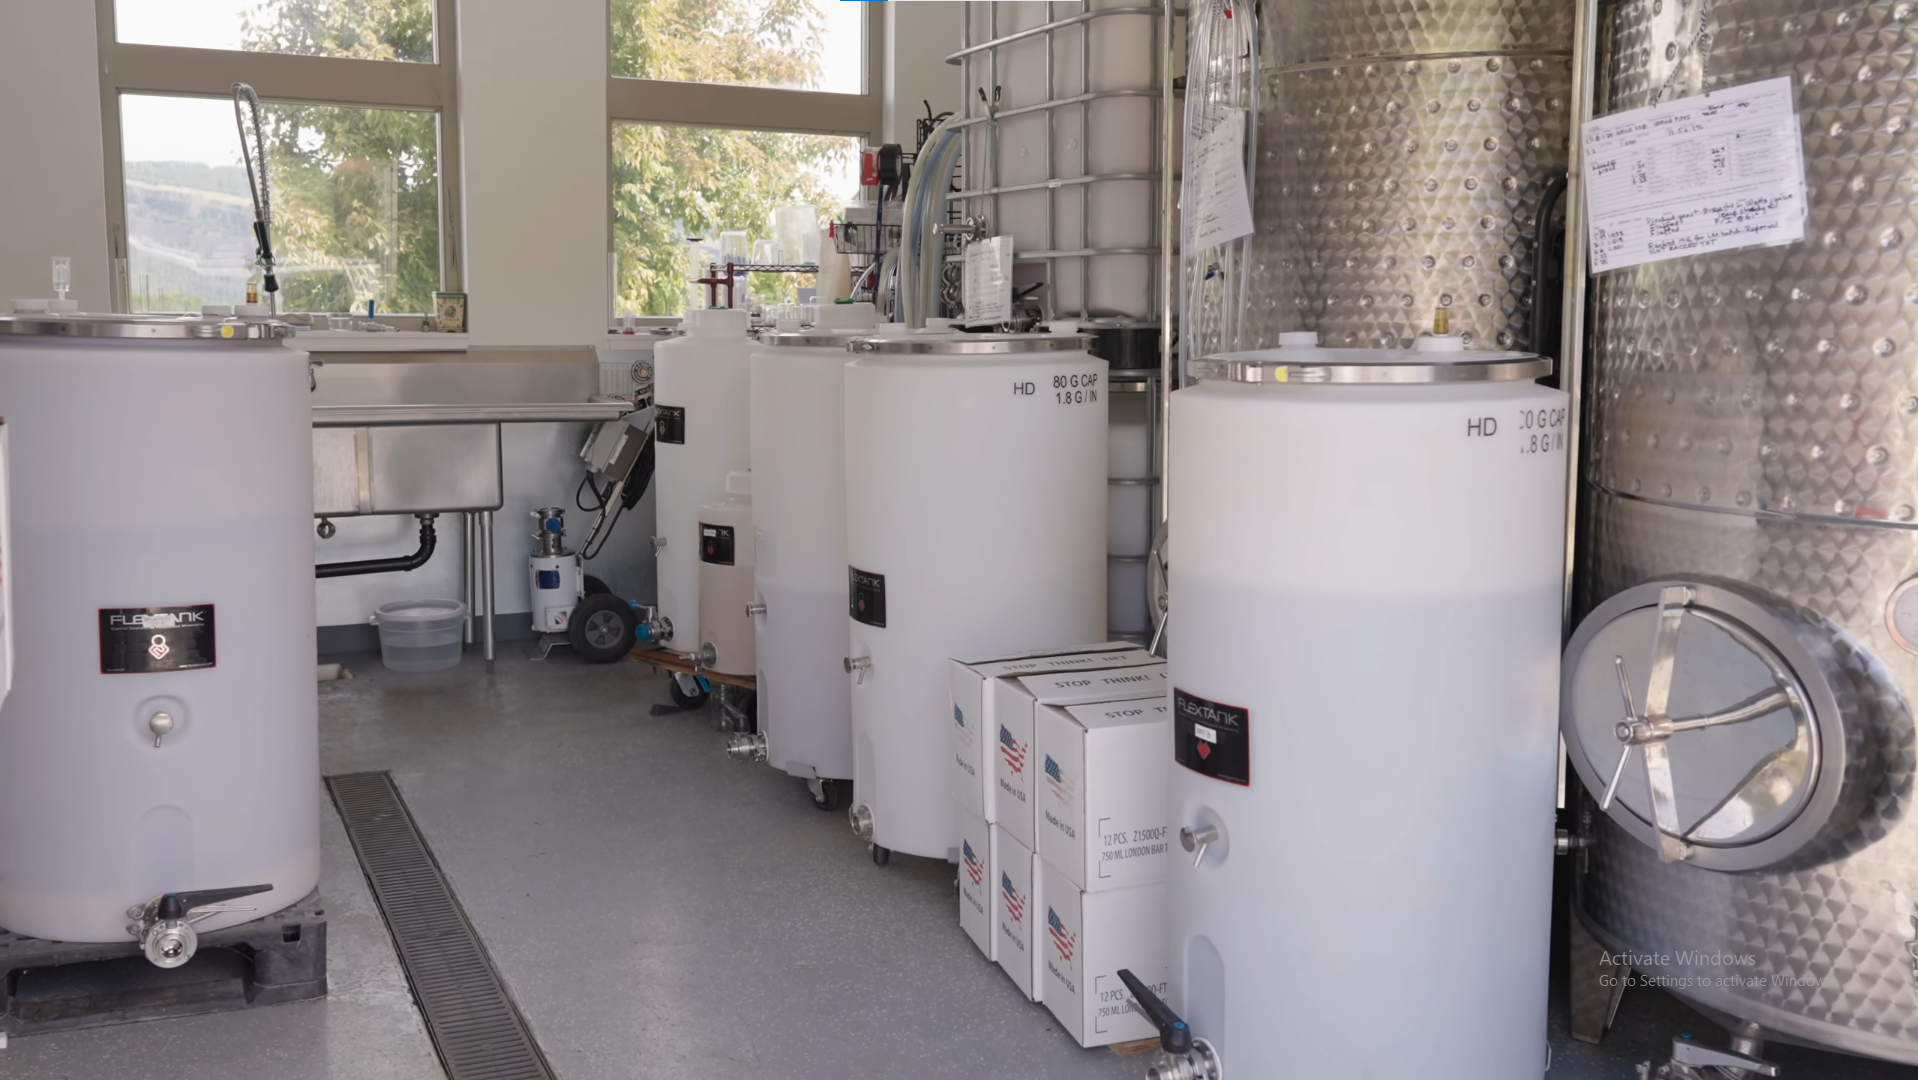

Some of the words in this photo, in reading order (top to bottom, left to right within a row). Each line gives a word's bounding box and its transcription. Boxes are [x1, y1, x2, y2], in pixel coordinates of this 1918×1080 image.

[1013, 382, 1036, 396] HD
[1053, 375, 1067, 389] 80
[1070, 374, 1079, 388] G
[1081, 373, 1098, 387] CAP
[1055, 391, 1073, 405] 1.8
[1467, 417, 1497, 437] HD
[1537, 409, 1547, 429] G
[1002, 662, 1038, 672] STOP
[1048, 657, 1094, 667] THINK!
[1102, 655, 1128, 663] LIFT
[1054, 679, 1091, 689] STOP
[1100, 674, 1151, 686] THINK!
[1105, 708, 1143, 719] STOP
[1178, 697, 1240, 727] FLEXTANK
[1000, 778, 1012, 794] Made
[1017, 790, 1026, 804] USA
[1045, 810, 1059, 828] Made
[1065, 824, 1076, 840] USA
[1103, 834, 1112, 846] 12
[1113, 832, 1128, 845] PCS.
[1133, 826, 1169, 842] Z1500Q-F
[1102, 850, 1113, 862] 750
[1114, 849, 1124, 860] ML
[1125, 845, 1150, 859] LONDON
[1151, 843, 1164, 855] BAR
[1048, 960, 1060, 980] Made
[1065, 978, 1076, 995] USA
[1100, 991, 1109, 1002] 12
[1098, 1006, 1110, 1017] 750
[1111, 1005, 1120, 1015] ML
